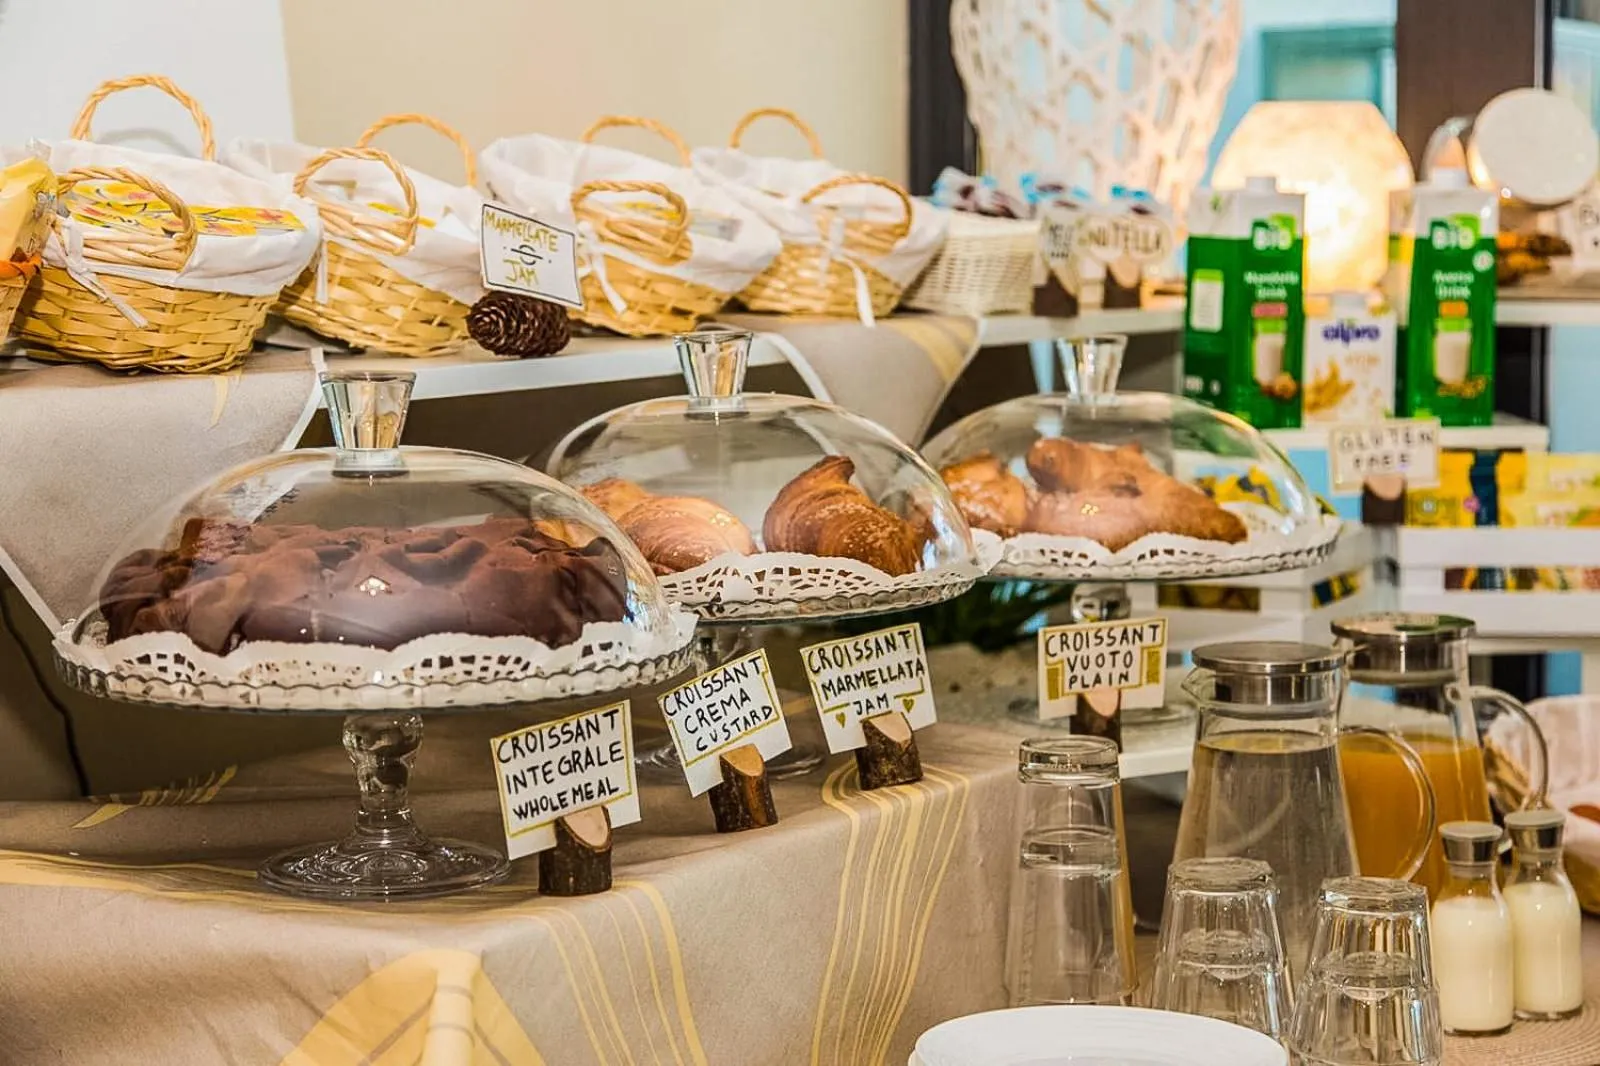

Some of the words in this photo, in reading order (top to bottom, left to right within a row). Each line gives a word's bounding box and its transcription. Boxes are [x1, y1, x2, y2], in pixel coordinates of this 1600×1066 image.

[503, 258, 538, 286] JAM
[1340, 426, 1434, 450] GLUTEN
[807, 630, 911, 674] CROISSANT
[1045, 624, 1159, 658] CROISSANT
[1067, 650, 1133, 673] VUOTO
[663, 656, 761, 717] CROISSANT
[821, 658, 925, 701] MARMELLATA
[1068, 671, 1129, 690] PLAIN
[685, 687, 751, 735] CREMA
[853, 692, 890, 716] JAM
[496, 708, 619, 764] CROISSANT
[696, 705, 773, 752] CUSTARD
[505, 740, 625, 795] INTEGRALE
